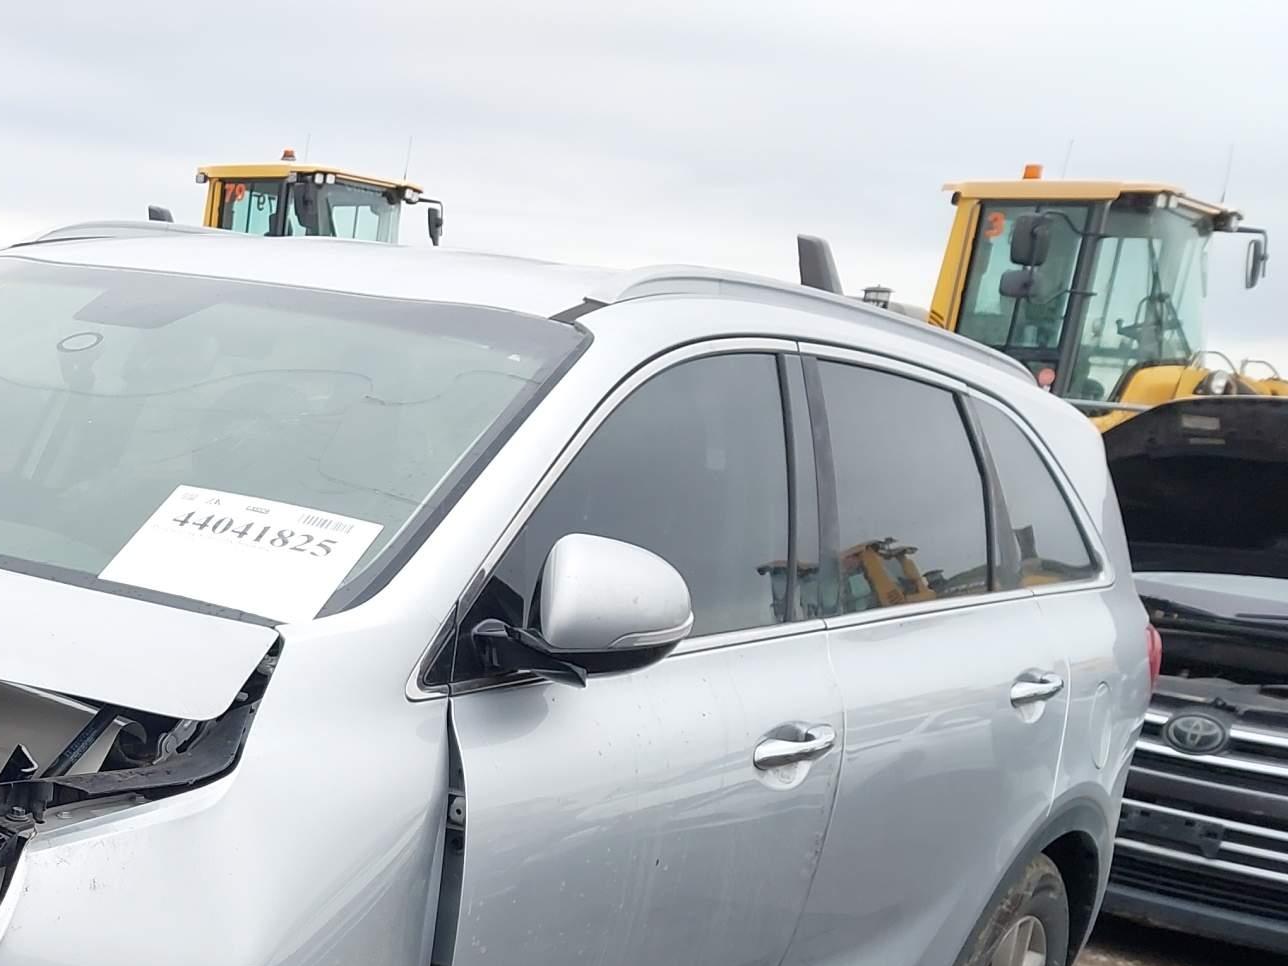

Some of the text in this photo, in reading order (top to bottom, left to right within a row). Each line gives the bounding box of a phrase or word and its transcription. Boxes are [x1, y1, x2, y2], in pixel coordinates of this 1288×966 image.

[225, 183, 246, 203] 79
[984, 211, 1005, 238] 3
[172, 510, 340, 557] 44041825
